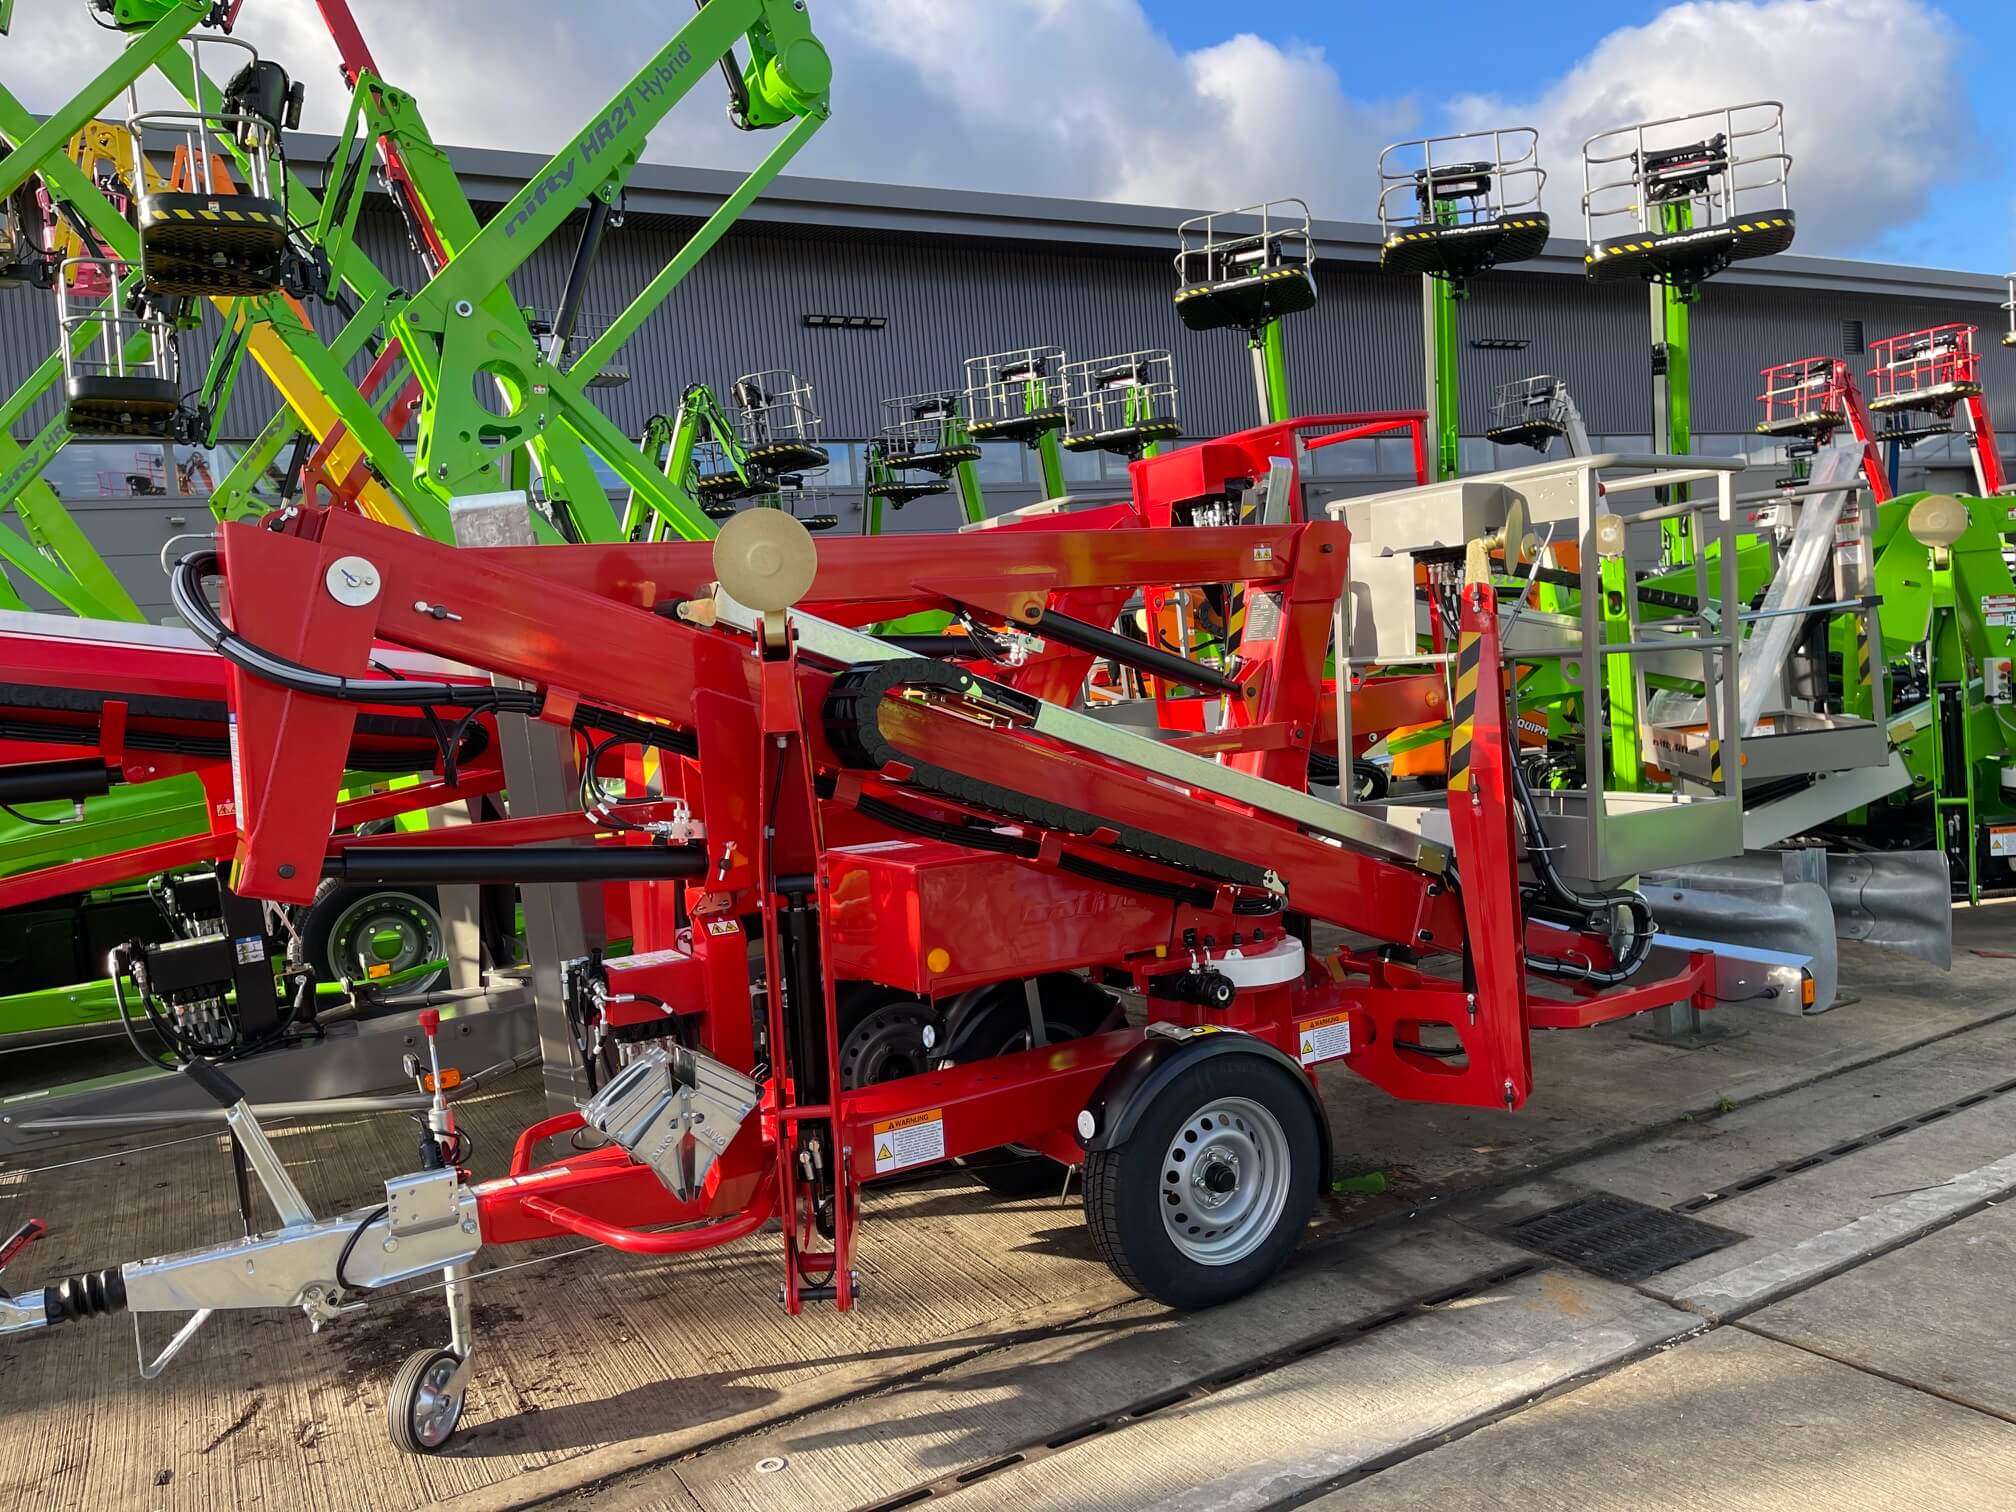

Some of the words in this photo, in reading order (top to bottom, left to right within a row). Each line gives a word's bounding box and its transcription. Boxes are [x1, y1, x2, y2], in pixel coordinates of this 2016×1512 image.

[504, 157, 576, 238] nifty
[579, 96, 637, 165] HR21
[635, 40, 693, 103] Hybrid
[895, 1113, 929, 1127] WARNING
